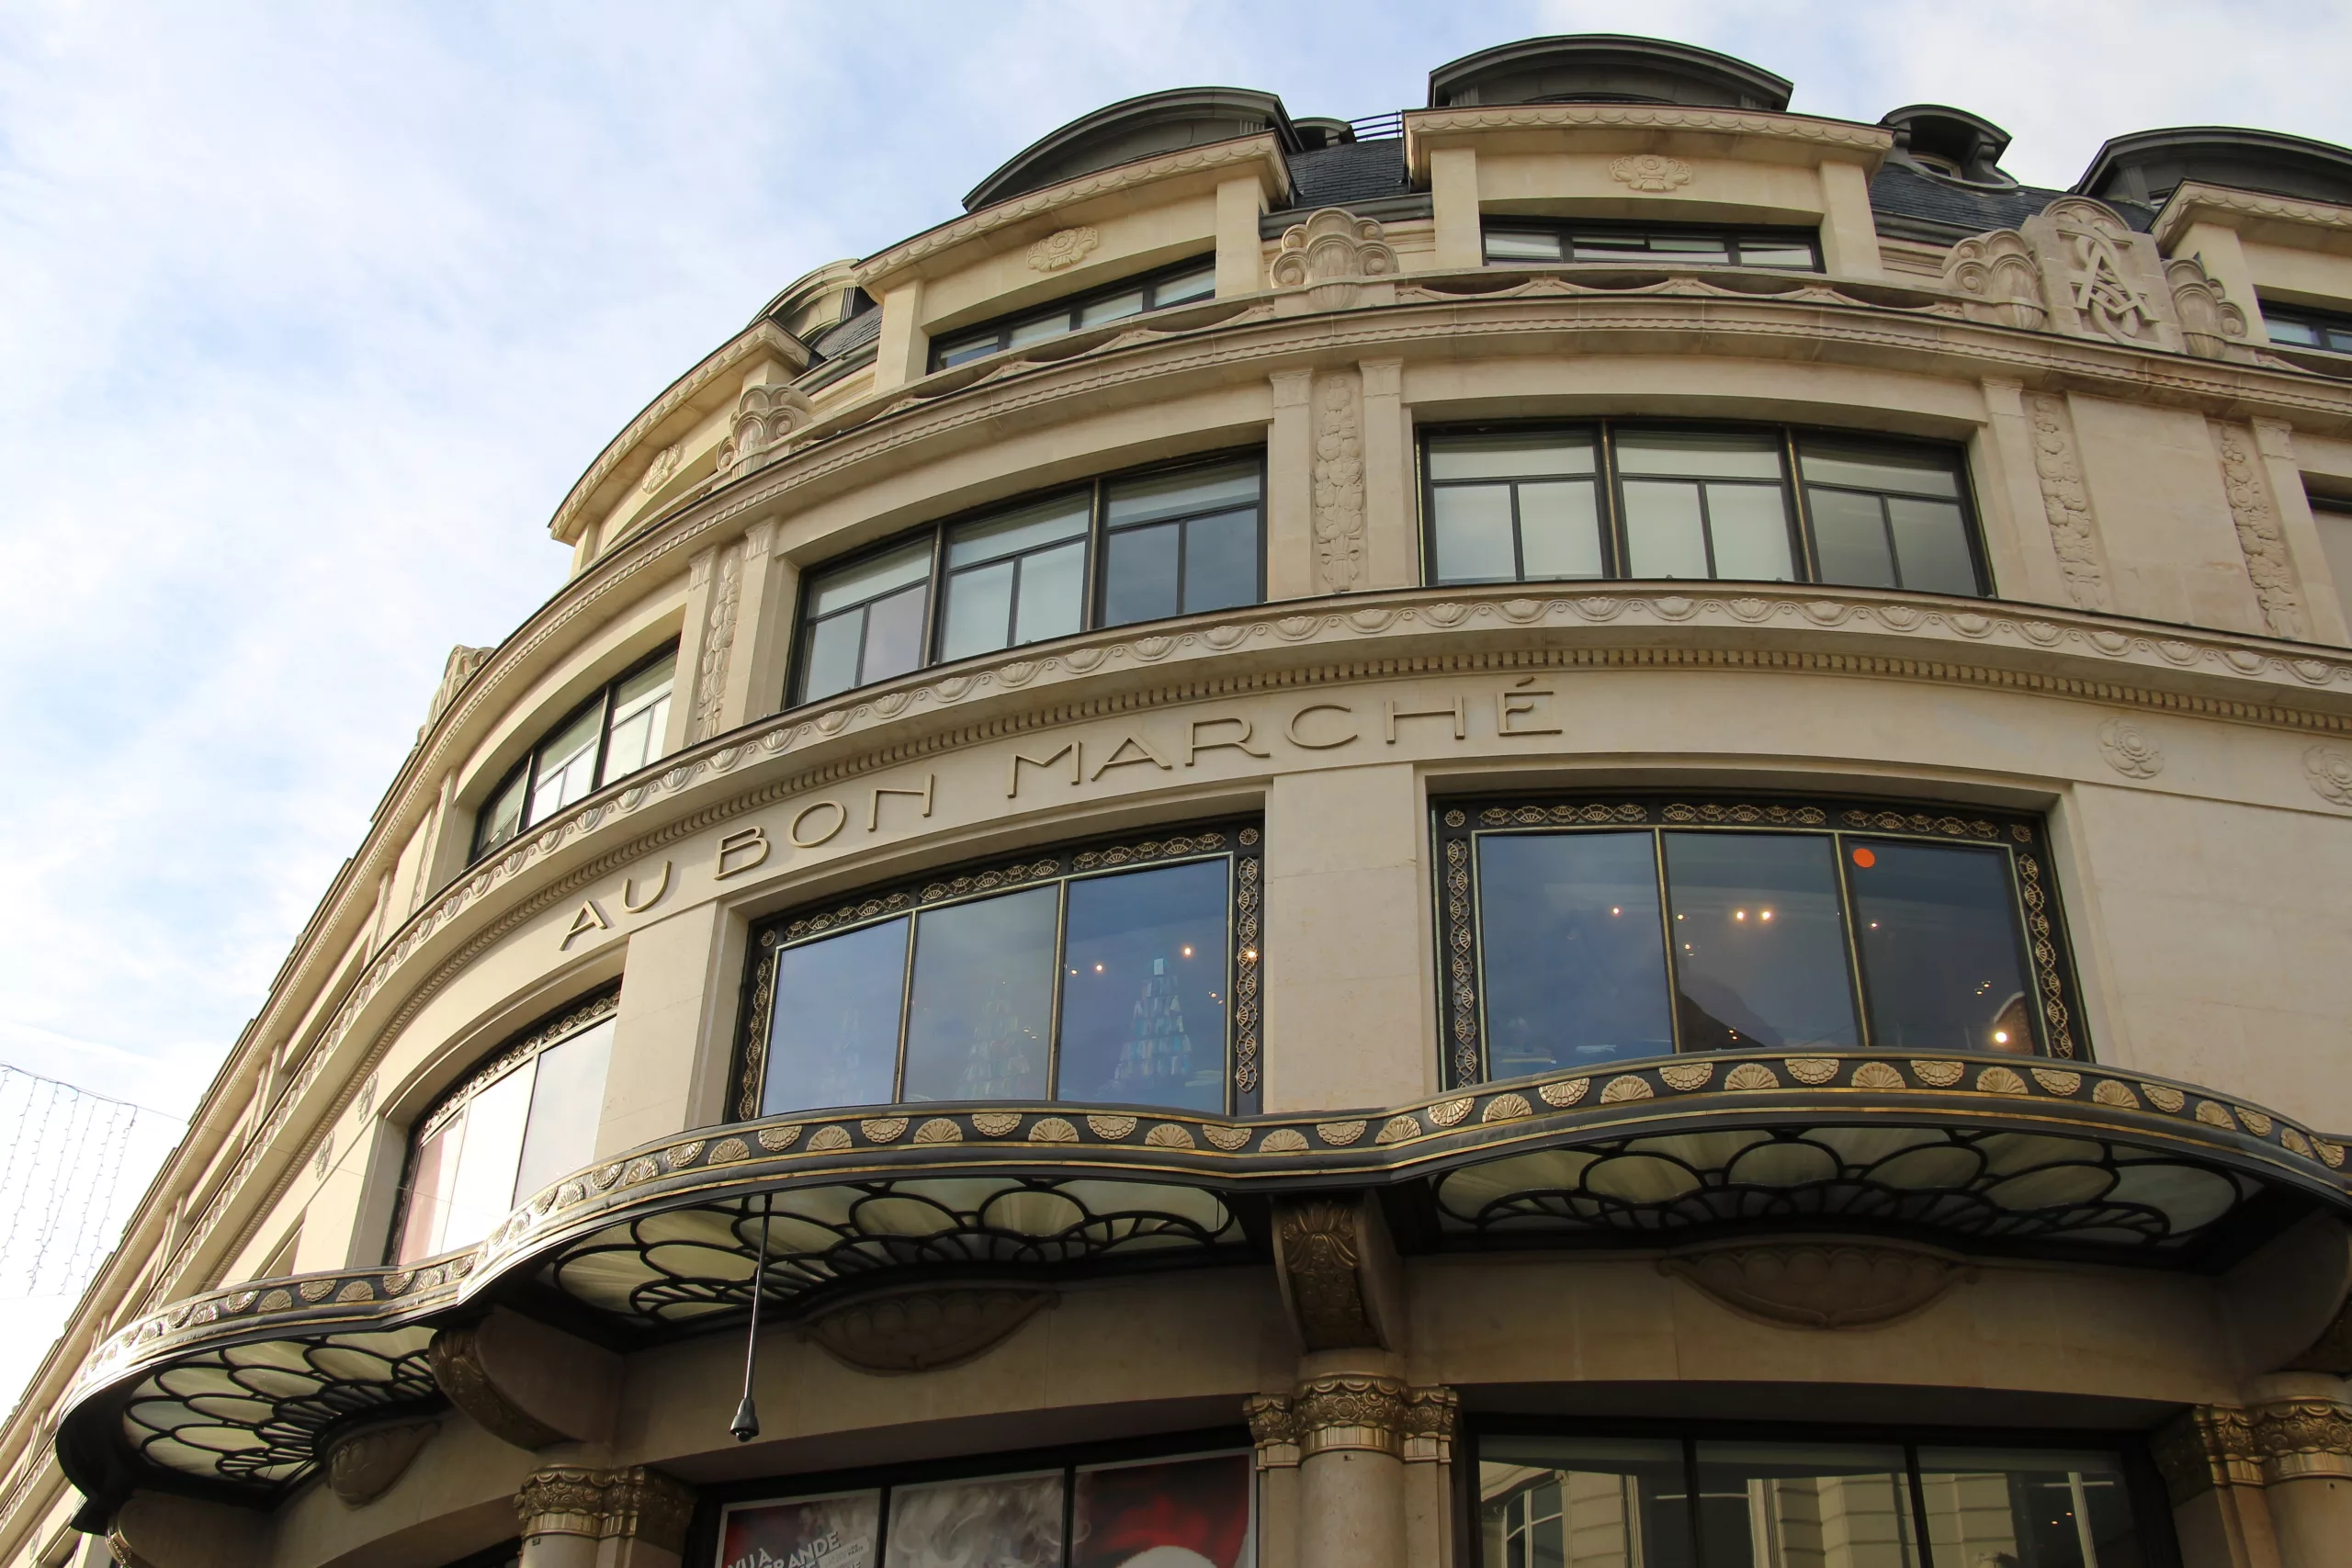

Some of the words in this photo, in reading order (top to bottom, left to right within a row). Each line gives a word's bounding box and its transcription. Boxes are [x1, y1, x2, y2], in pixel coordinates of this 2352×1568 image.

[558, 860, 672, 952] AU
[713, 773, 934, 882] BON
[1007, 675, 1563, 799] MARCHÉ
